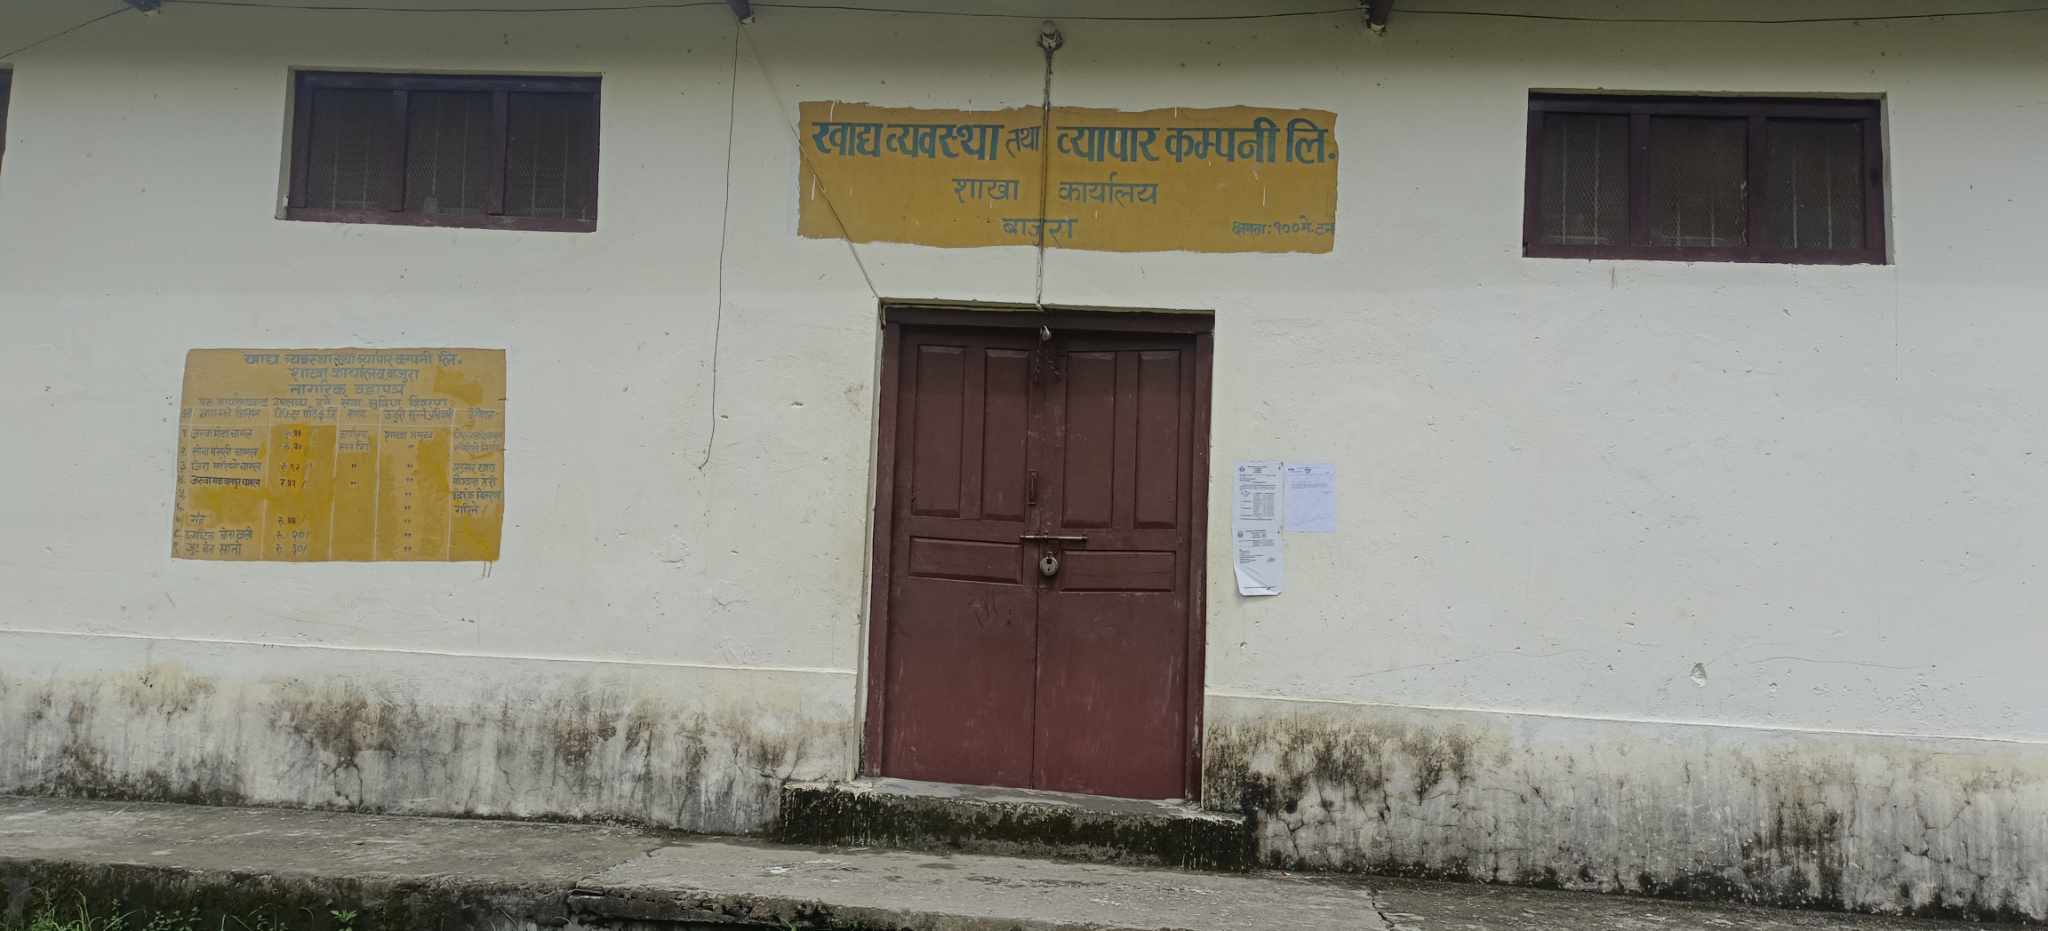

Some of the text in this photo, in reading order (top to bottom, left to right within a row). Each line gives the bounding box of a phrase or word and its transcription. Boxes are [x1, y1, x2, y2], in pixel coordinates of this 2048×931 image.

[812, 117, 1336, 164] खाद्य व्यवस्था तथा व्यापार कम्पनी लि.
[952, 171, 1158, 208] शाखा कार्यालय
